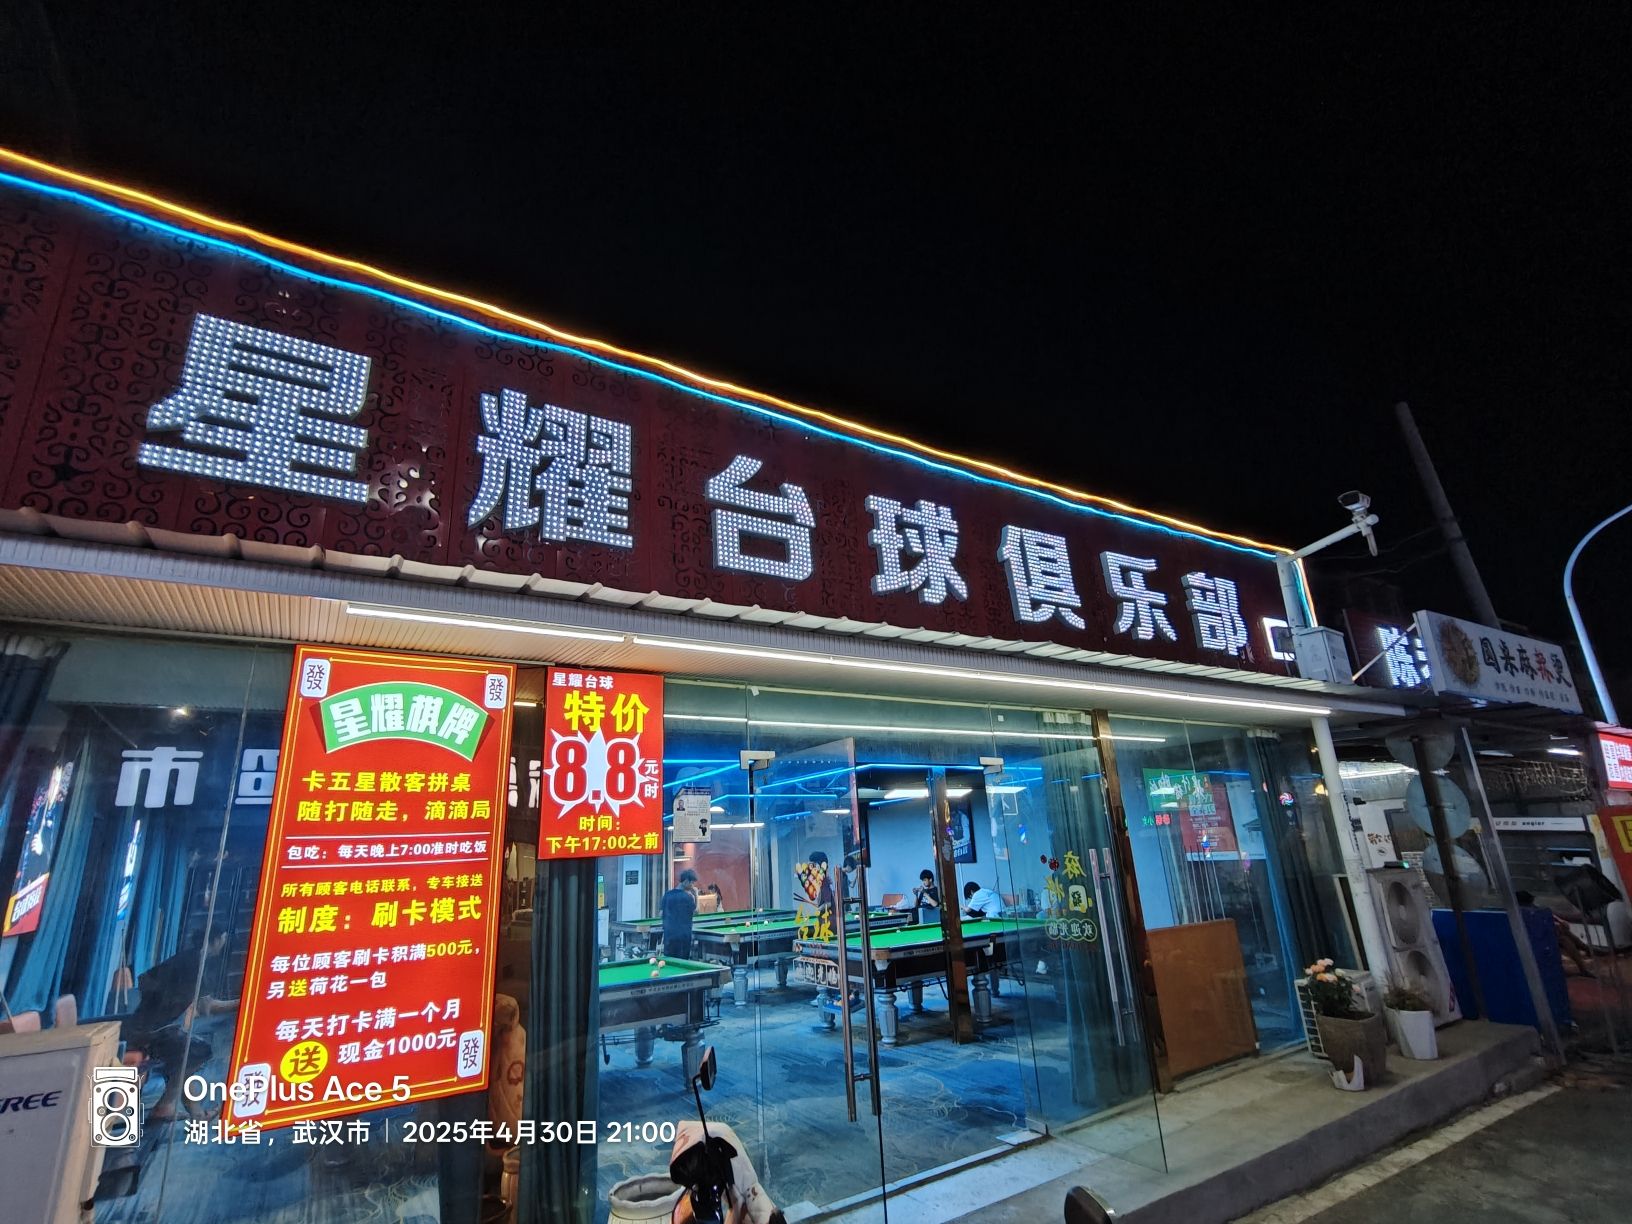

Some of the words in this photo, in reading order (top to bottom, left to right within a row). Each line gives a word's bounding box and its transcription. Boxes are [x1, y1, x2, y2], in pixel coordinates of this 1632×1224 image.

[137, 312, 1249, 657] 星耀台球俱乐部
[552, 672, 614, 690] 星耀台球
[329, 692, 480, 746] 星耀棋牌
[563, 691, 650, 734] 特价
[302, 771, 471, 794] 卡五星散客拼桌
[297, 800, 491, 823] 随打随走，滴滴局
[286, 840, 487, 860] 包吃：每天晚上7:00准时吃饭
[546, 836, 659, 853] 下午17:00之前
[281, 874, 483, 899] 所有顾客电话联系，专车接送
[266, 970, 387, 1000] 另送荷花一包
[275, 998, 461, 1042] 每天打卡满一个月
[288, 1045, 320, 1078] 送
[338, 1028, 457, 1065] 现金1000元
[0, 1090, 62, 1114] REE
